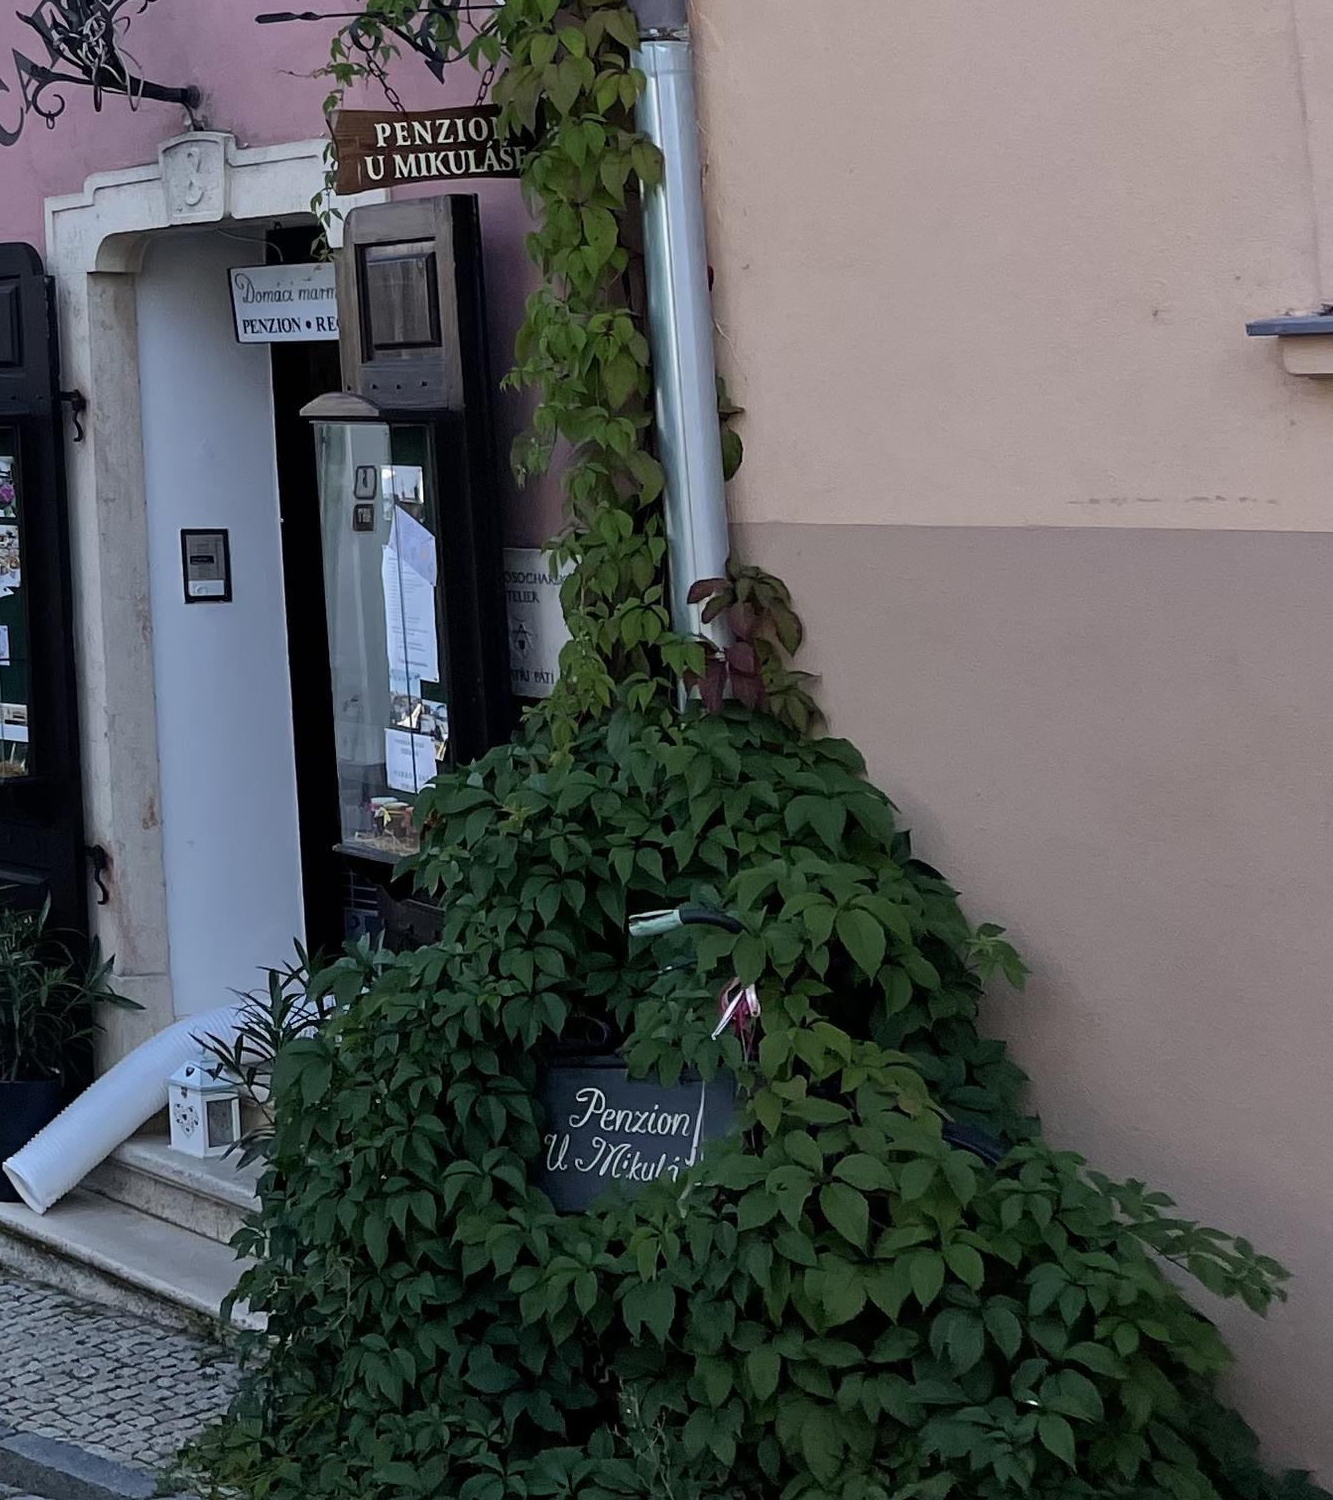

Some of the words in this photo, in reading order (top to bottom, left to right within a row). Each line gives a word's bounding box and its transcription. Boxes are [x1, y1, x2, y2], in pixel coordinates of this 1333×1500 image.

[364, 155, 385, 181] U
[242, 317, 302, 335] PENZION
[569, 1087, 690, 1137] Penzion
[544, 1133, 568, 1172] U
